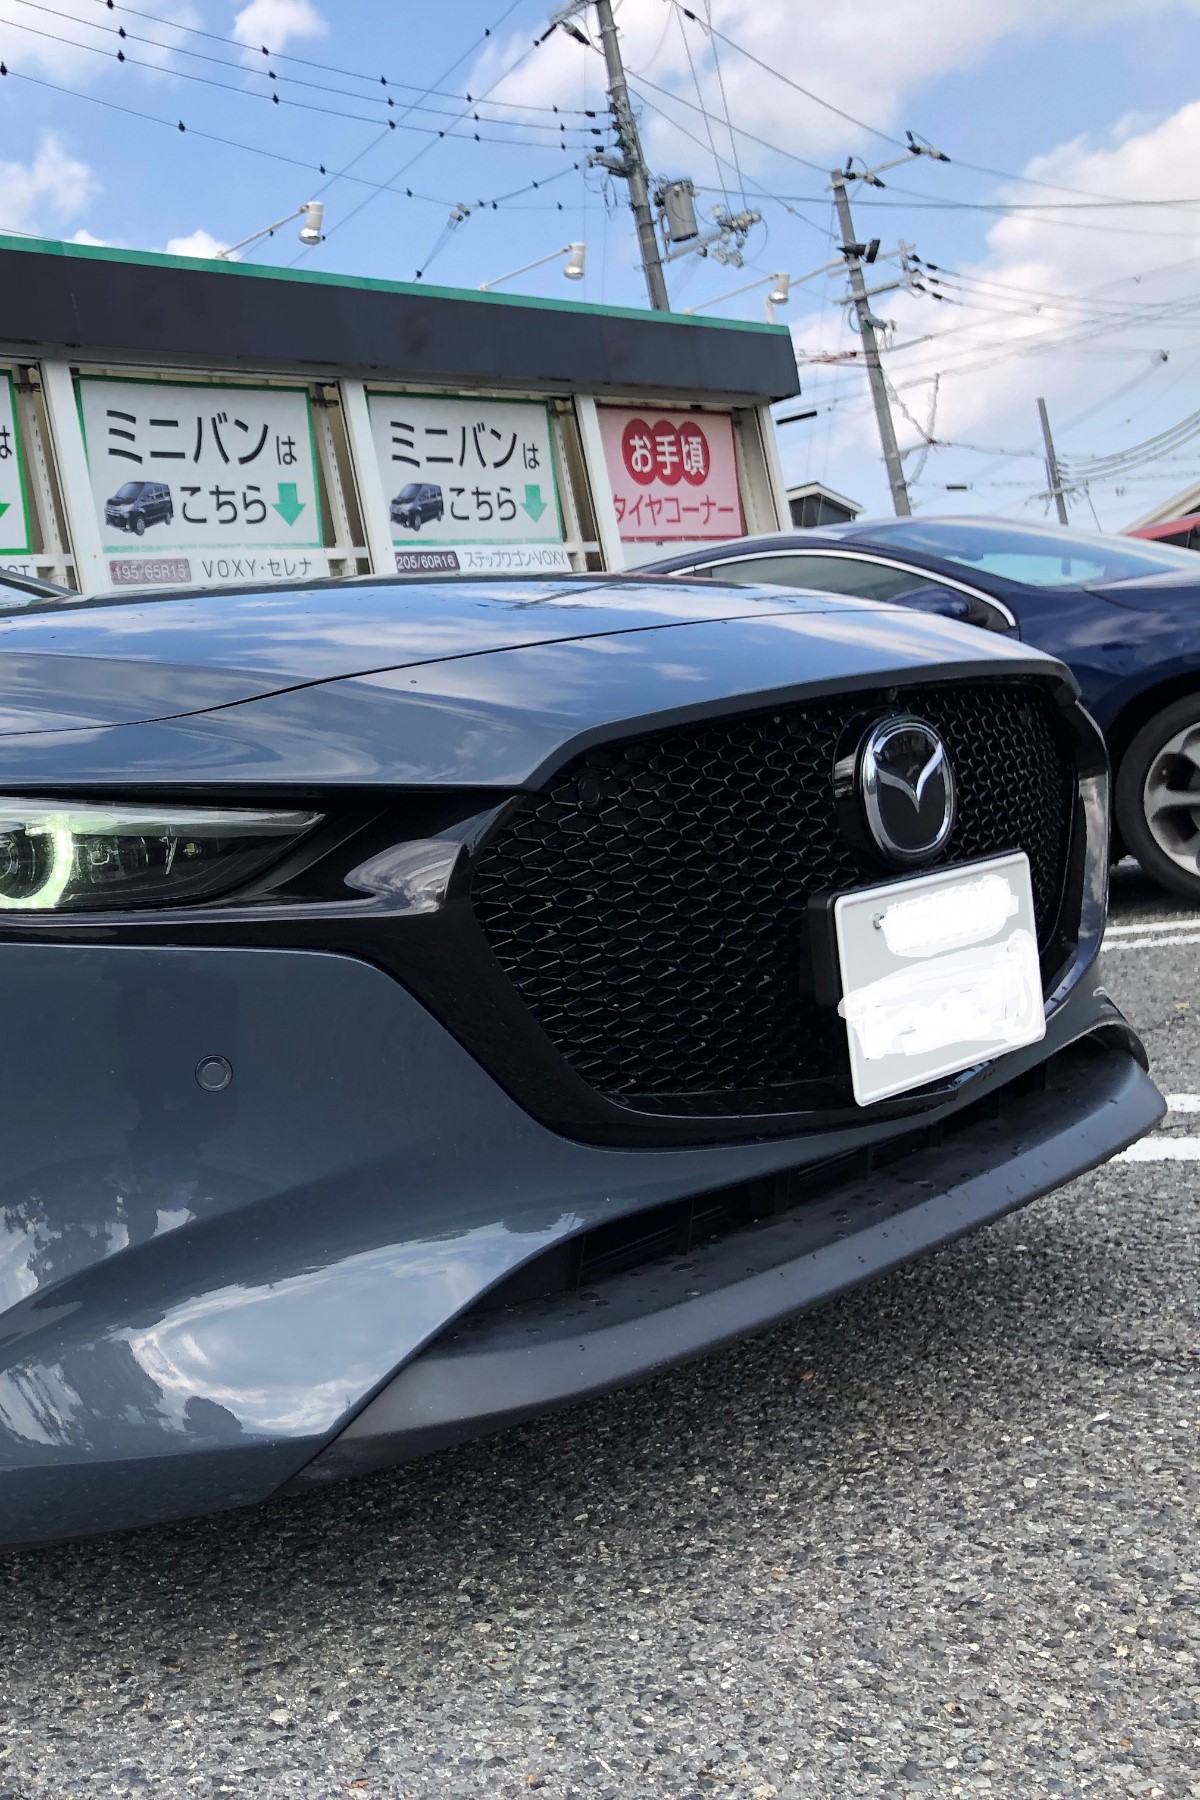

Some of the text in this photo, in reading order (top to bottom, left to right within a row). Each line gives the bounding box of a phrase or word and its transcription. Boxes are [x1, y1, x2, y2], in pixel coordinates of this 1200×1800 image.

[106, 409, 298, 466] ミニバンは
[390, 421, 540, 470] ミニバンは
[629, 434, 707, 477] お手頃
[179, 484, 267, 525] こちら
[449, 486, 517, 522] こちら
[613, 493, 734, 527] タイヤコーナー
[396, 554, 457, 570] 205/60R16
